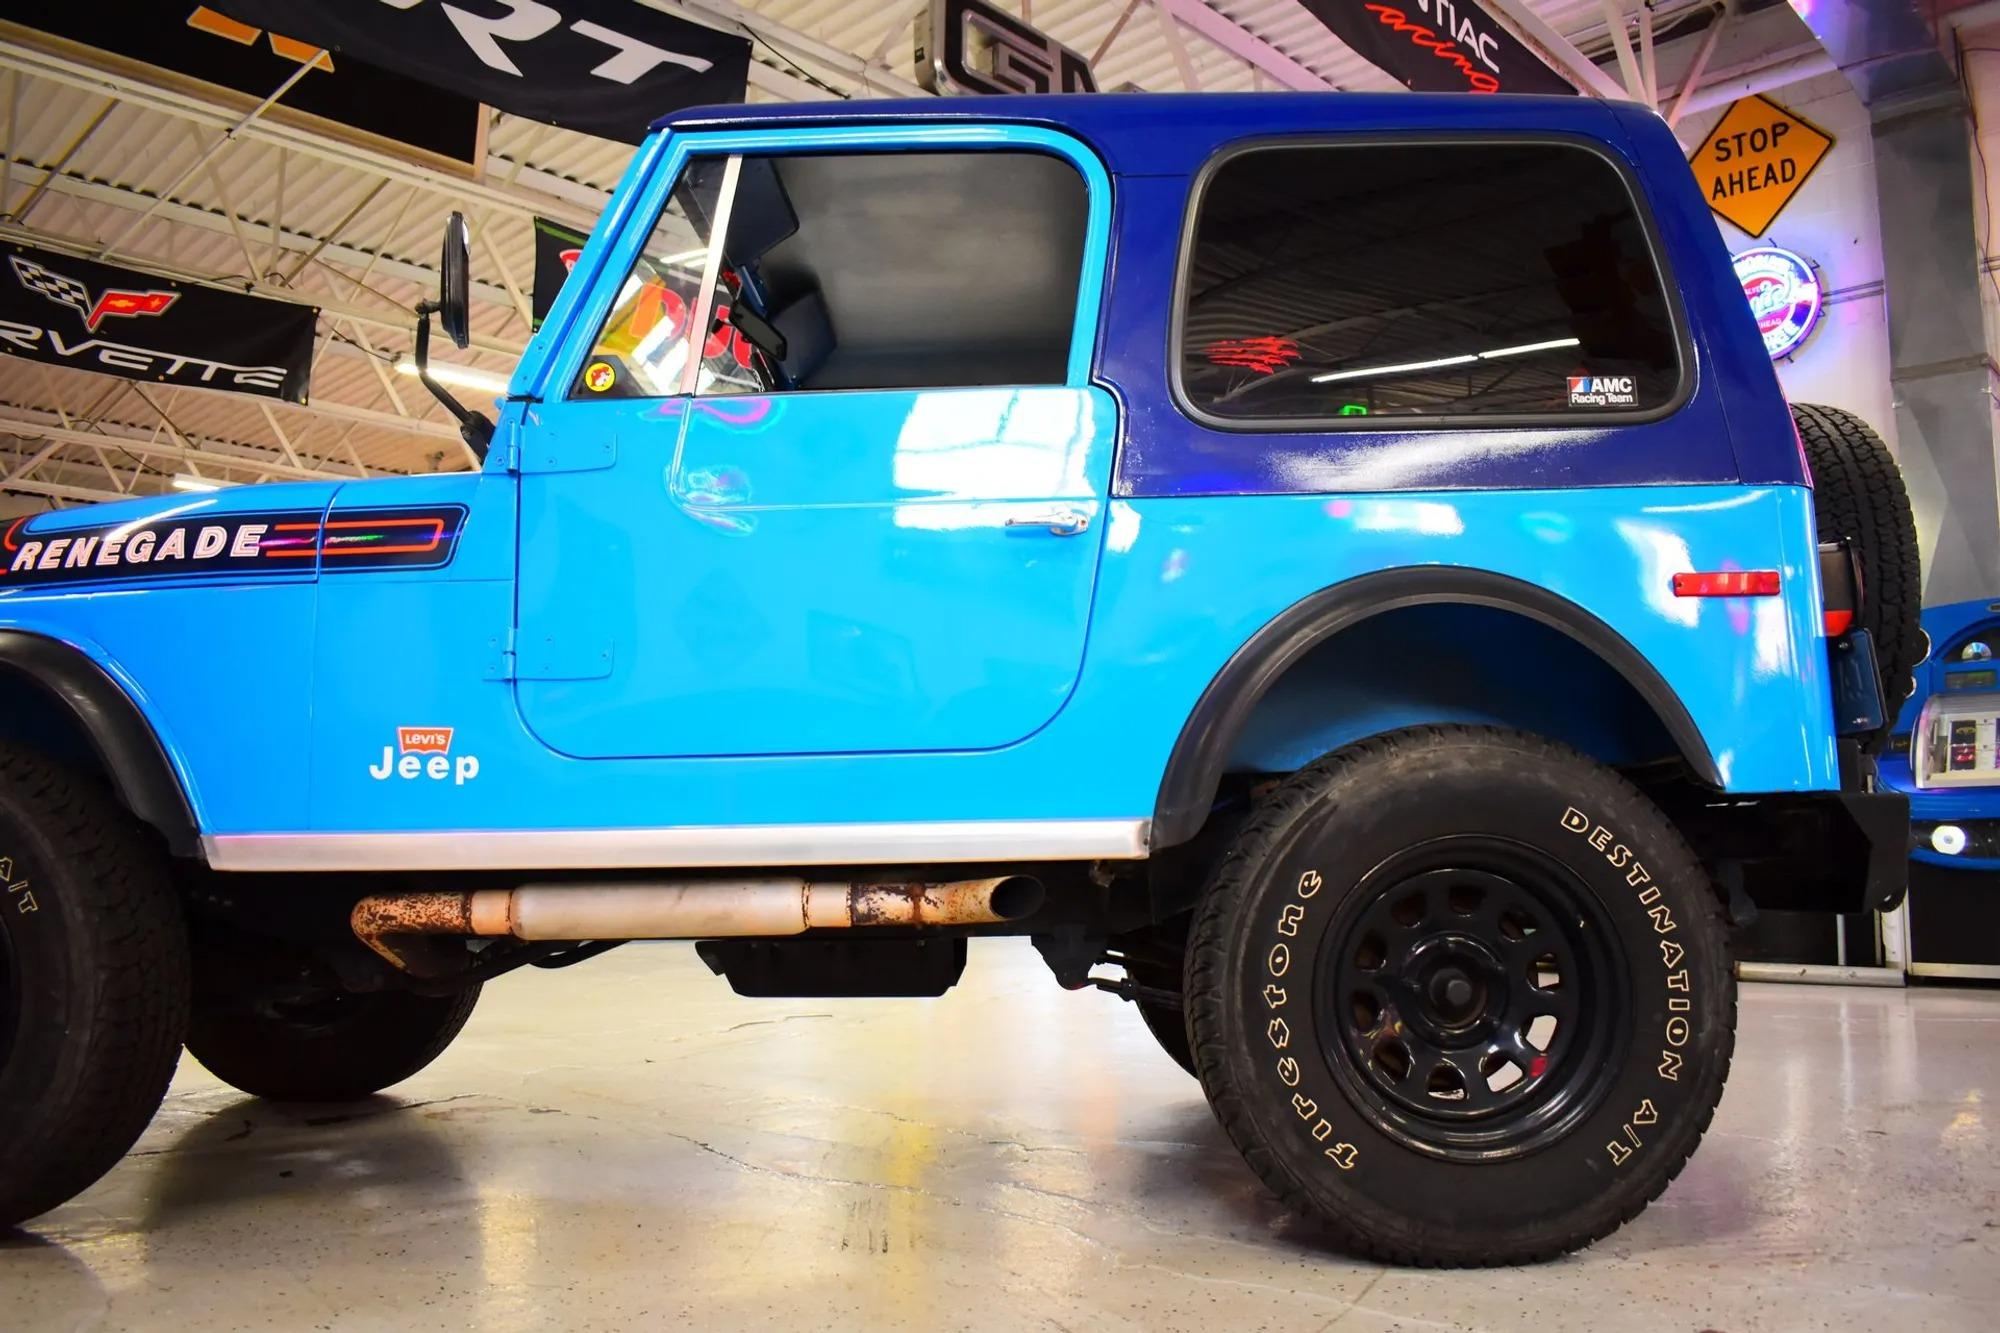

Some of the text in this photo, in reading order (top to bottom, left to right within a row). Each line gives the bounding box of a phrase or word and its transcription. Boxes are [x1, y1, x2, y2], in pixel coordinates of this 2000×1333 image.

[379, 0, 714, 85] RT
[1715, 122, 1790, 162] STOP
[1712, 158, 1796, 201] AHEAD
[1571, 392, 1634, 406] Racing Team
[1590, 378, 1633, 393] AMC
[10, 524, 270, 571] RENEGADE
[369, 745, 480, 785] Jeep
[1560, 807, 1691, 1166] DESTINATION A/T
[1263, 869, 1359, 1169] Firestone
